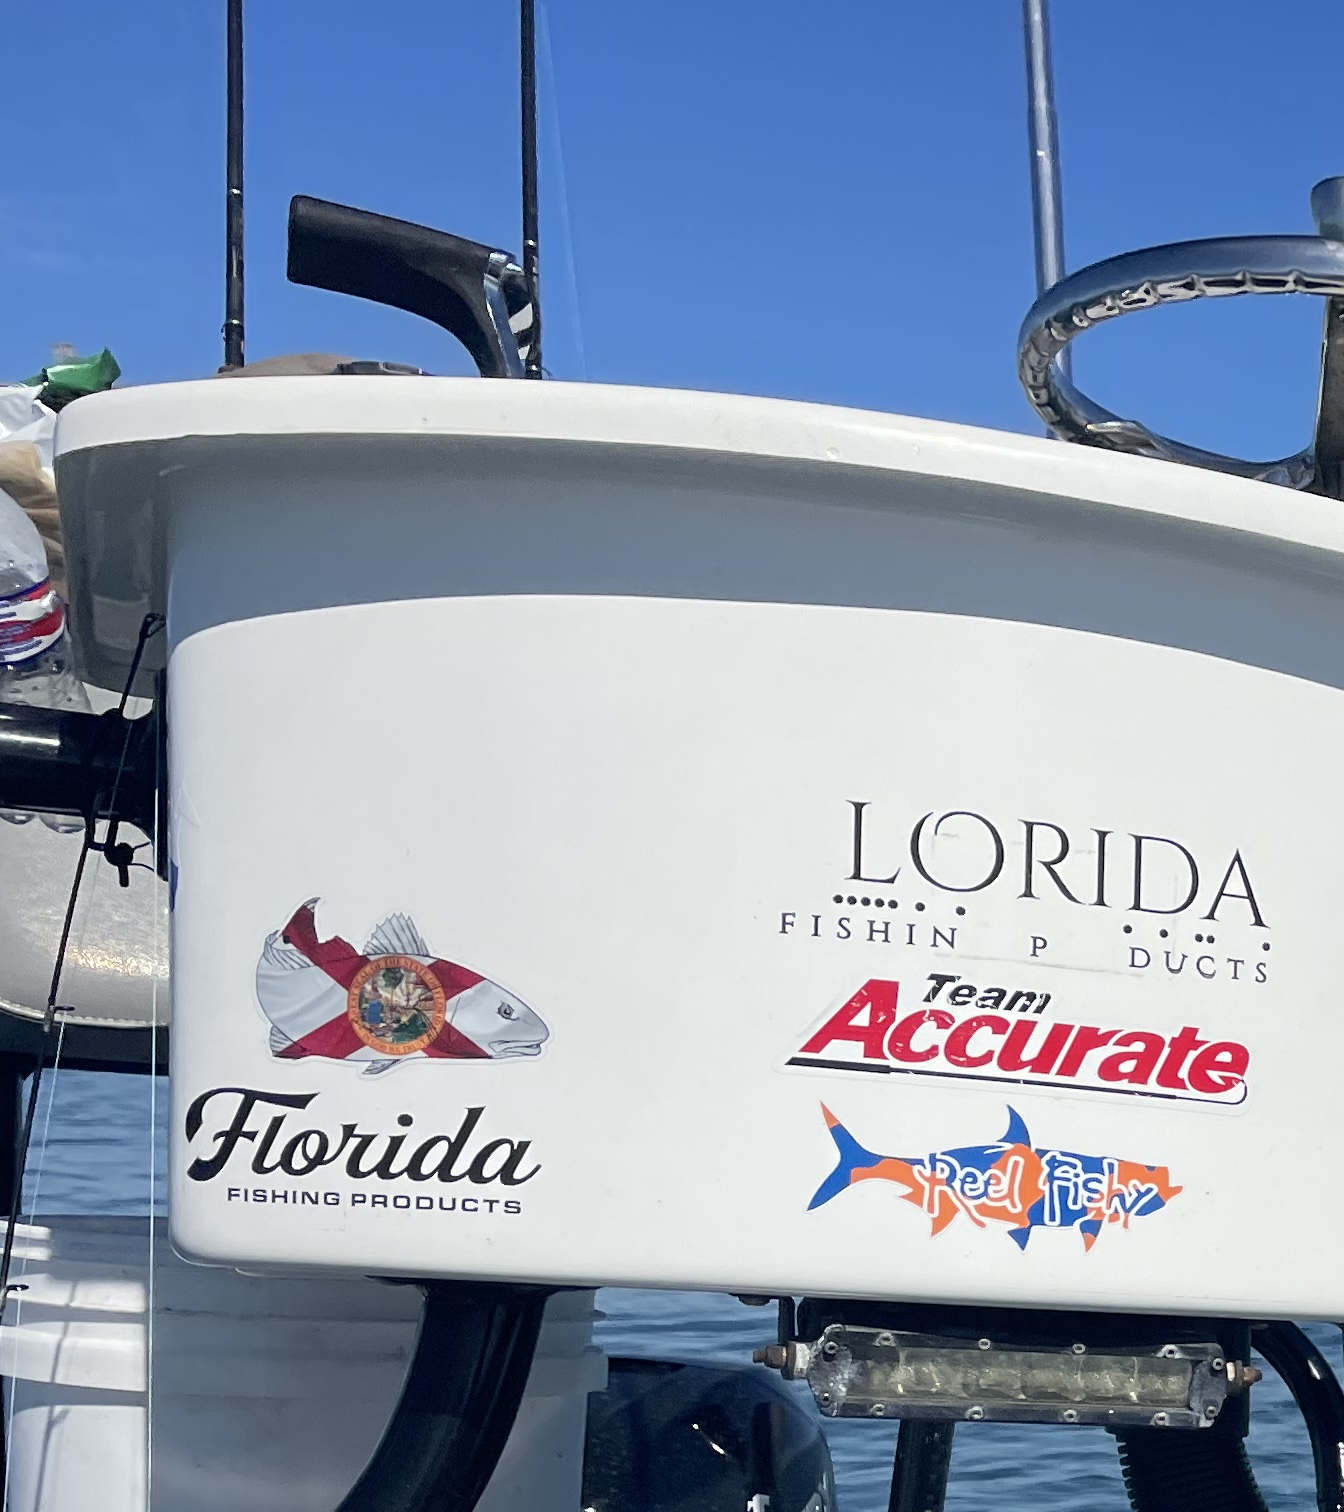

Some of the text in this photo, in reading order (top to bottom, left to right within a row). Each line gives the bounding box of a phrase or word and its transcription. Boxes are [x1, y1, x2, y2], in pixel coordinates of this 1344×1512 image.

[778, 911, 958, 949] FISHIN
[921, 972, 1052, 1015] Team
[797, 977, 1251, 1095] Accurate
[185, 1085, 541, 1187] Florida
[226, 1186, 522, 1216] FISHING PRODUCTS
[913, 1150, 1160, 1230] Reel Fishy
